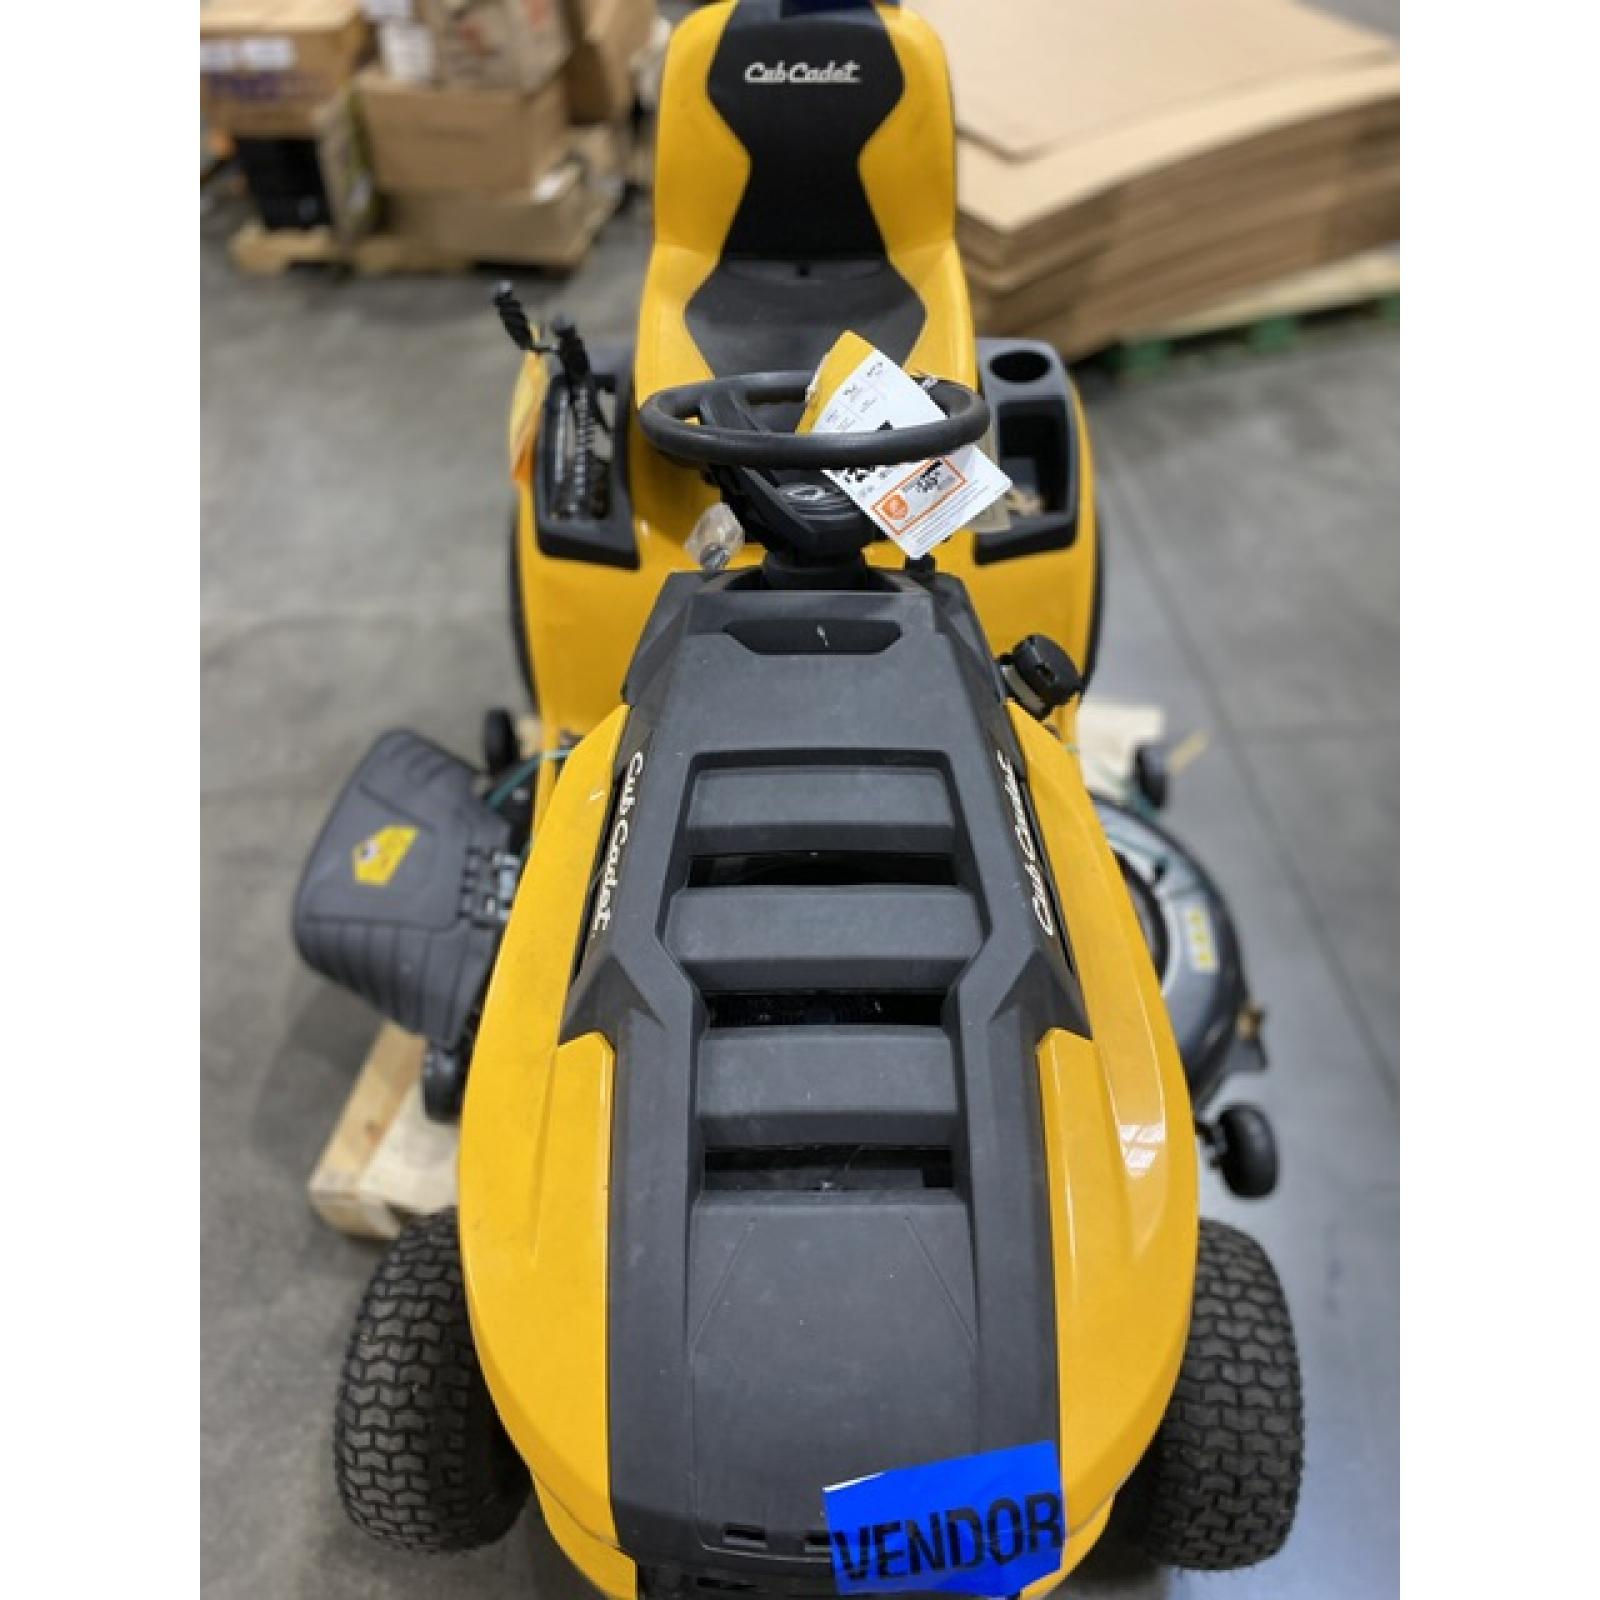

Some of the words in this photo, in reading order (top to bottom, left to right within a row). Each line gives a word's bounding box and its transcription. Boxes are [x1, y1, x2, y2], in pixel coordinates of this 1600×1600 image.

[744, 60, 786, 84] Cub
[789, 60, 862, 84] Cadet
[619, 751, 644, 816] Cub
[593, 819, 629, 931] Cadet
[832, 1491, 1063, 1580] VENDOR
